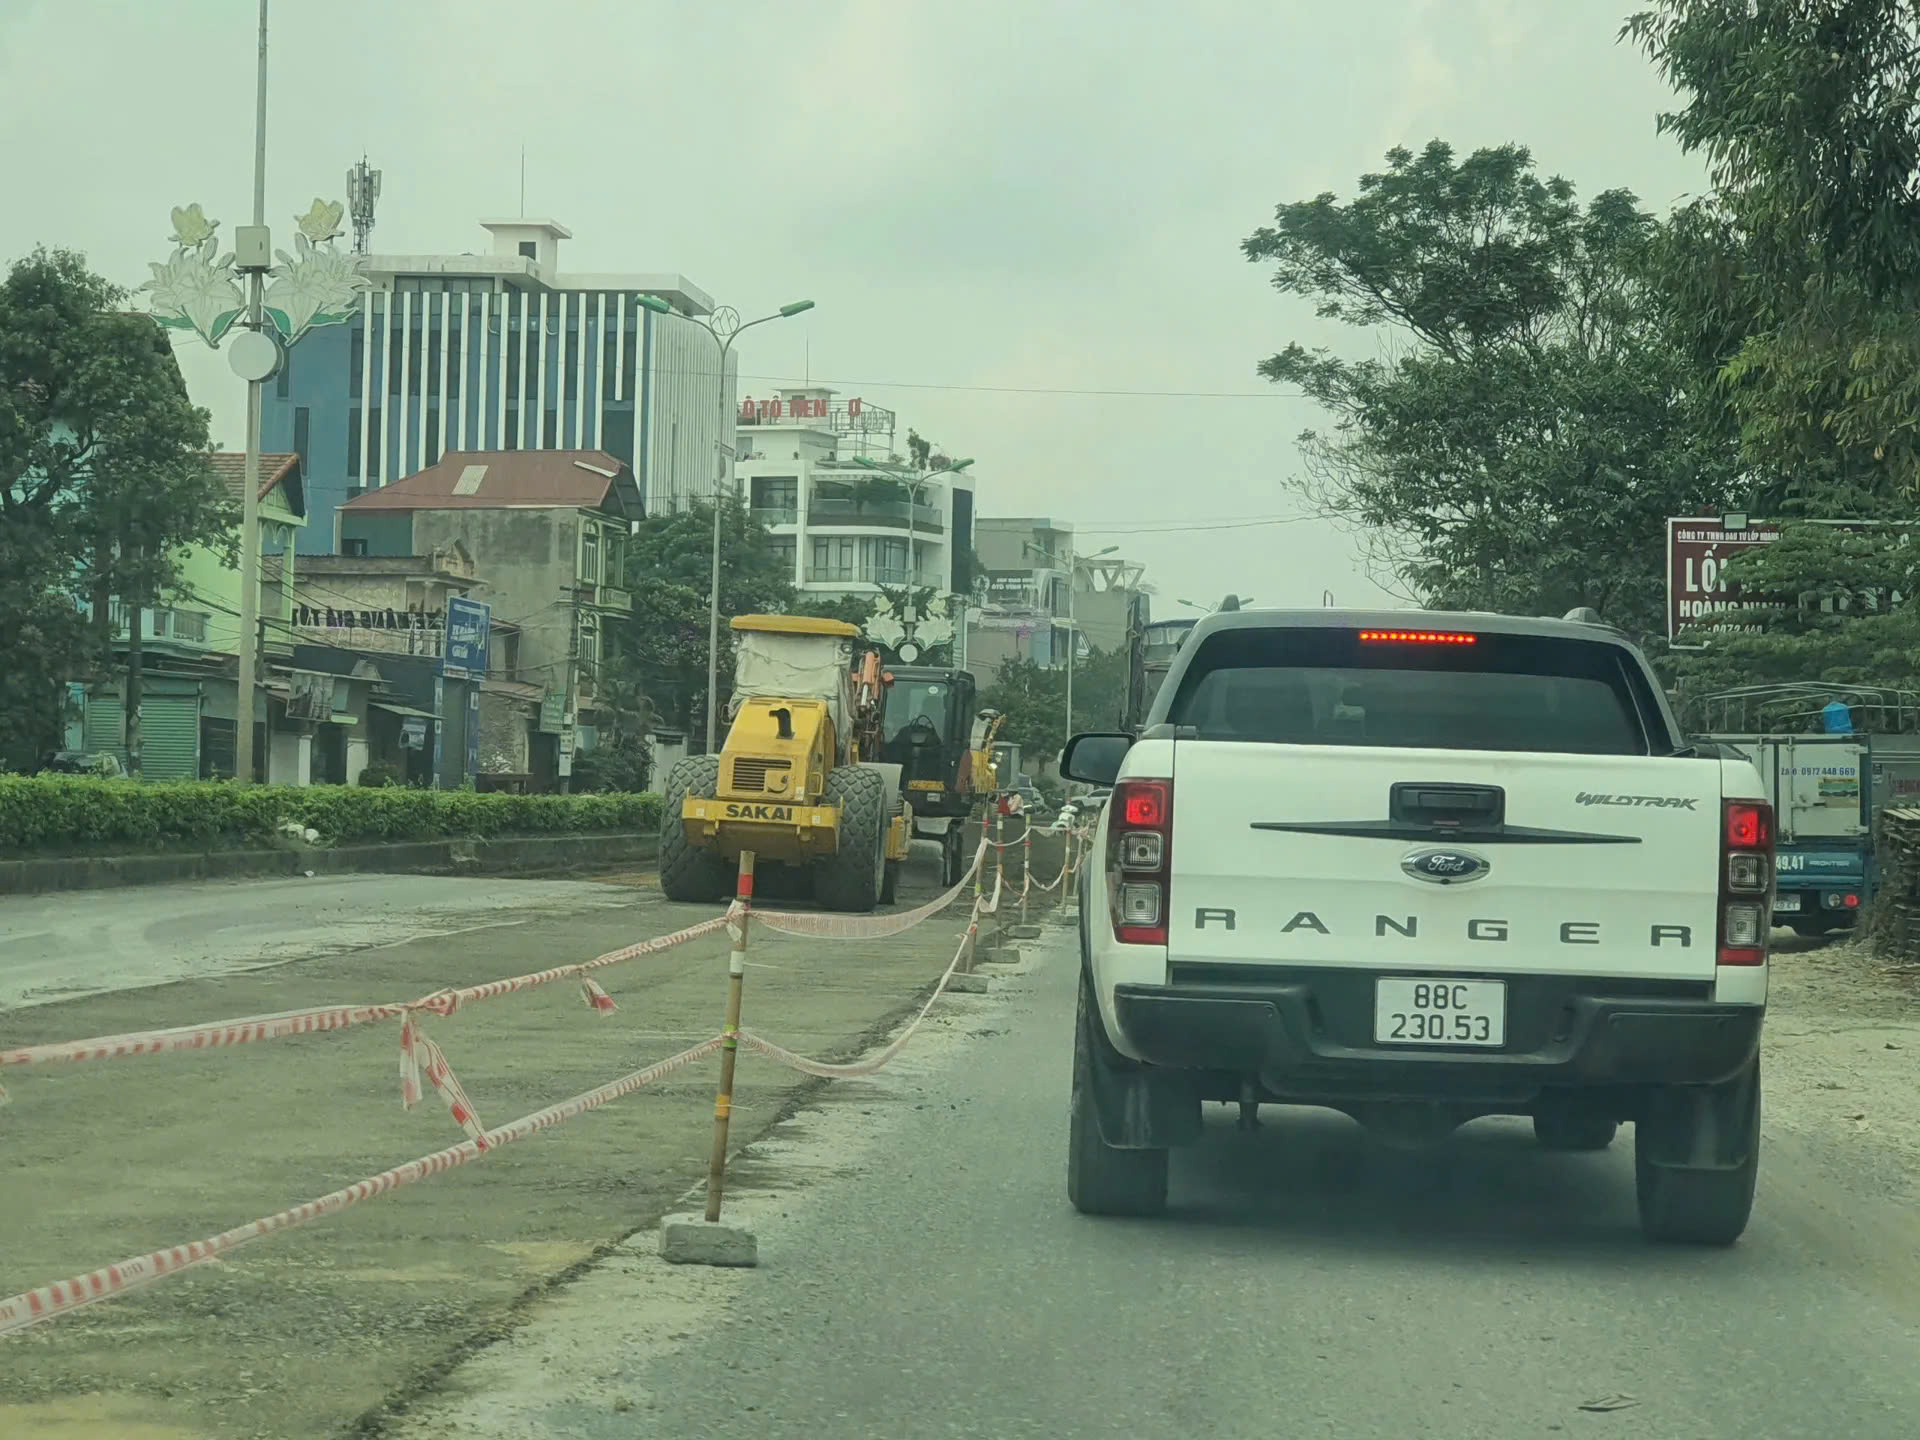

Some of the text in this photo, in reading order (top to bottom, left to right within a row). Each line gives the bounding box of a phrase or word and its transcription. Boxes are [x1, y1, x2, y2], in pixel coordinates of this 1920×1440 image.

[1677, 528, 1696, 541] CÔNG
[1697, 531, 1705, 541] TY
[1706, 531, 1725, 541] TNHH
[1575, 791, 1700, 811] WILDTRAK
[726, 805, 793, 821] SAKAI
[1428, 855, 1465, 872] Ford
[1194, 907, 1692, 947] RANGER
[1413, 983, 1469, 1010] 88C
[1390, 1013, 1490, 1041] 230.53
